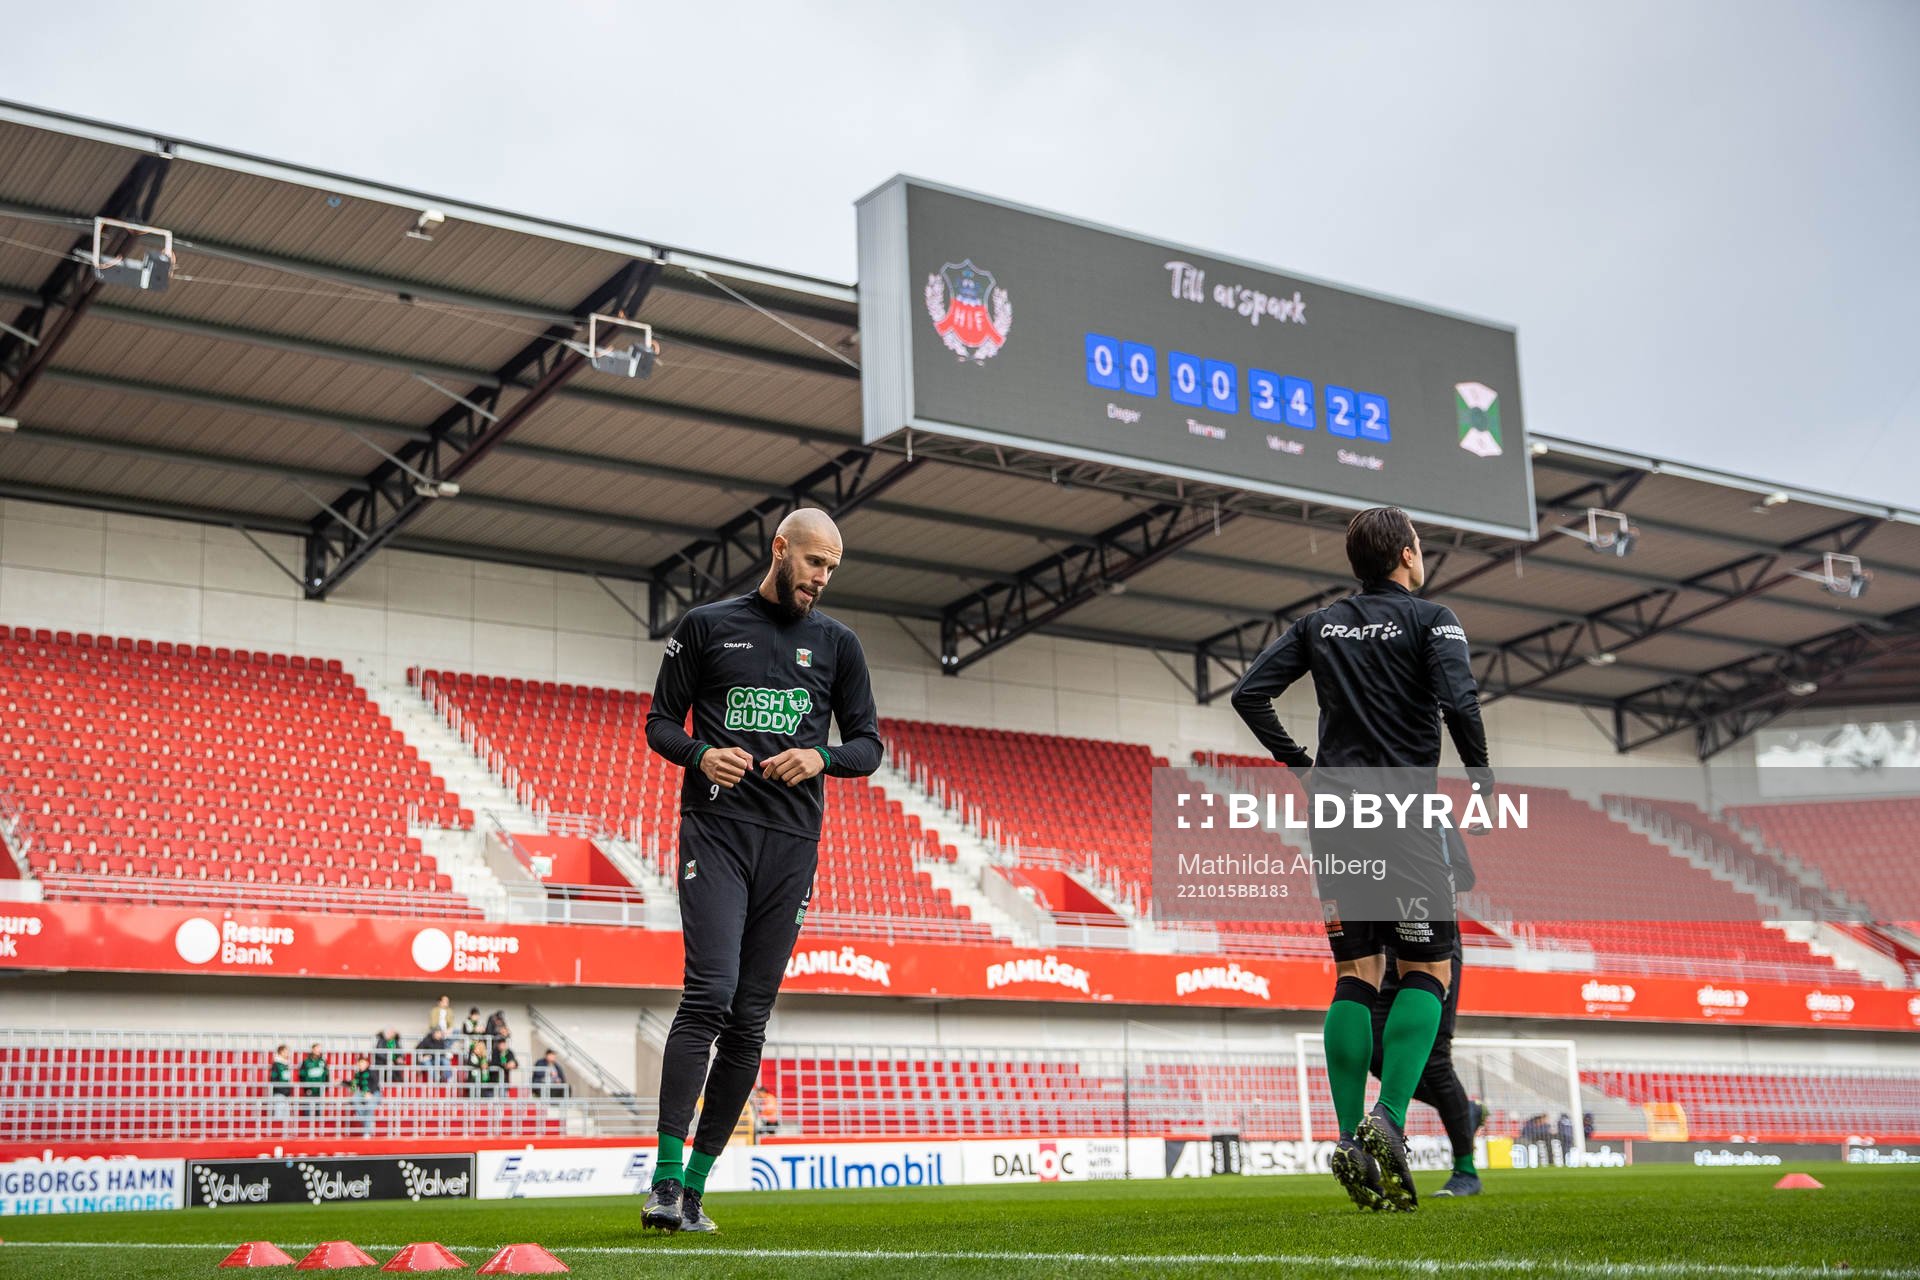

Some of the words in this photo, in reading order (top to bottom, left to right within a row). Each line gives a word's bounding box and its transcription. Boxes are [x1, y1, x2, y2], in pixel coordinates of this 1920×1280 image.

[1163, 260, 1206, 303] Till
[1257, 379, 1309, 417] 34
[1332, 395, 1382, 431] 22
[1320, 623, 1384, 640] CRAFT
[730, 691, 785, 712] CASH
[729, 709, 798, 731] BUDDY
[709, 783, 720, 801] 9
[1395, 896, 1429, 921] VS
[222, 920, 294, 945] Resurs
[453, 930, 519, 954] Resurs
[222, 942, 274, 966] Bank
[453, 951, 501, 973] Bank
[986, 955, 1090, 994] RAMLÖSA
[1175, 963, 1270, 1000] RAMLÖSA
[781, 1154, 944, 1189] Tillmobil
[993, 1150, 1073, 1178] DALOC
[0, 1170, 99, 1195] GBORGS
[108, 1168, 174, 1191] HAMN
[208, 1173, 271, 1202] Valvet
[312, 1170, 372, 1199] Valvet
[411, 1168, 469, 1197] Valvet
